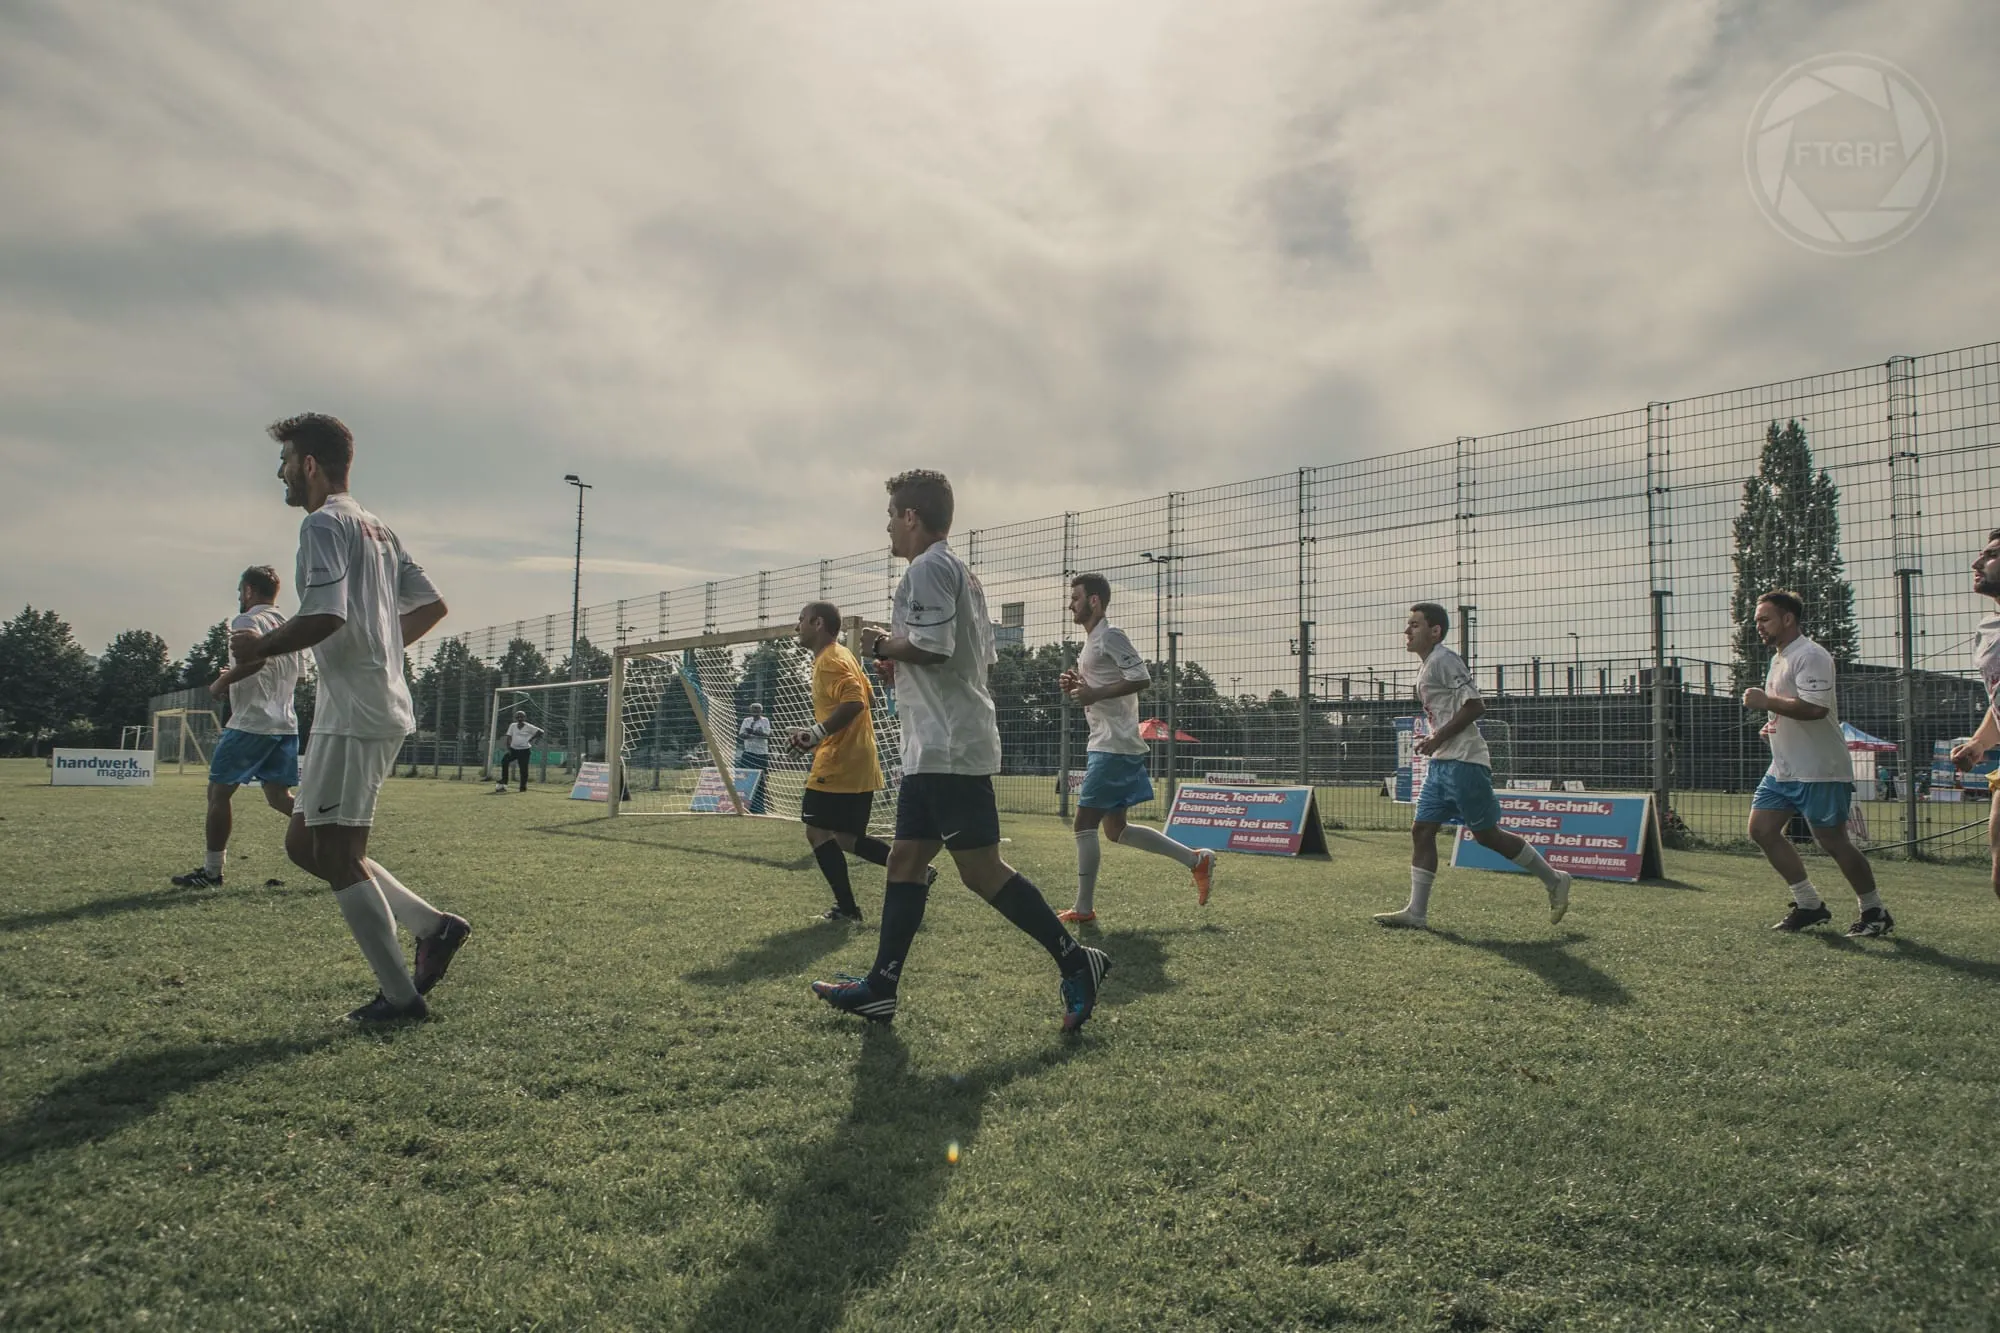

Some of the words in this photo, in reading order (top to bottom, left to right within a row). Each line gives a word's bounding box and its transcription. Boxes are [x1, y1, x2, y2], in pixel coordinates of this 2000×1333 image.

[56, 756, 139, 769] handwerk
[96, 768, 151, 780] magazin
[1181, 789, 1229, 802] Einsatz,
[1232, 792, 1285, 804] Technik,
[1178, 802, 1246, 815] Teamgeist:
[1537, 799, 1610, 815] Technik,
[1172, 816, 1211, 825] genau
[1213, 817, 1237, 827] wie
[1239, 818, 1261, 829] bei
[1261, 821, 1289, 830] uns.
[1553, 833, 1583, 846] bei
[1584, 838, 1624, 848] uns.
[1549, 854, 1569, 863] DAS
[1571, 854, 1627, 867] HANDWERK
